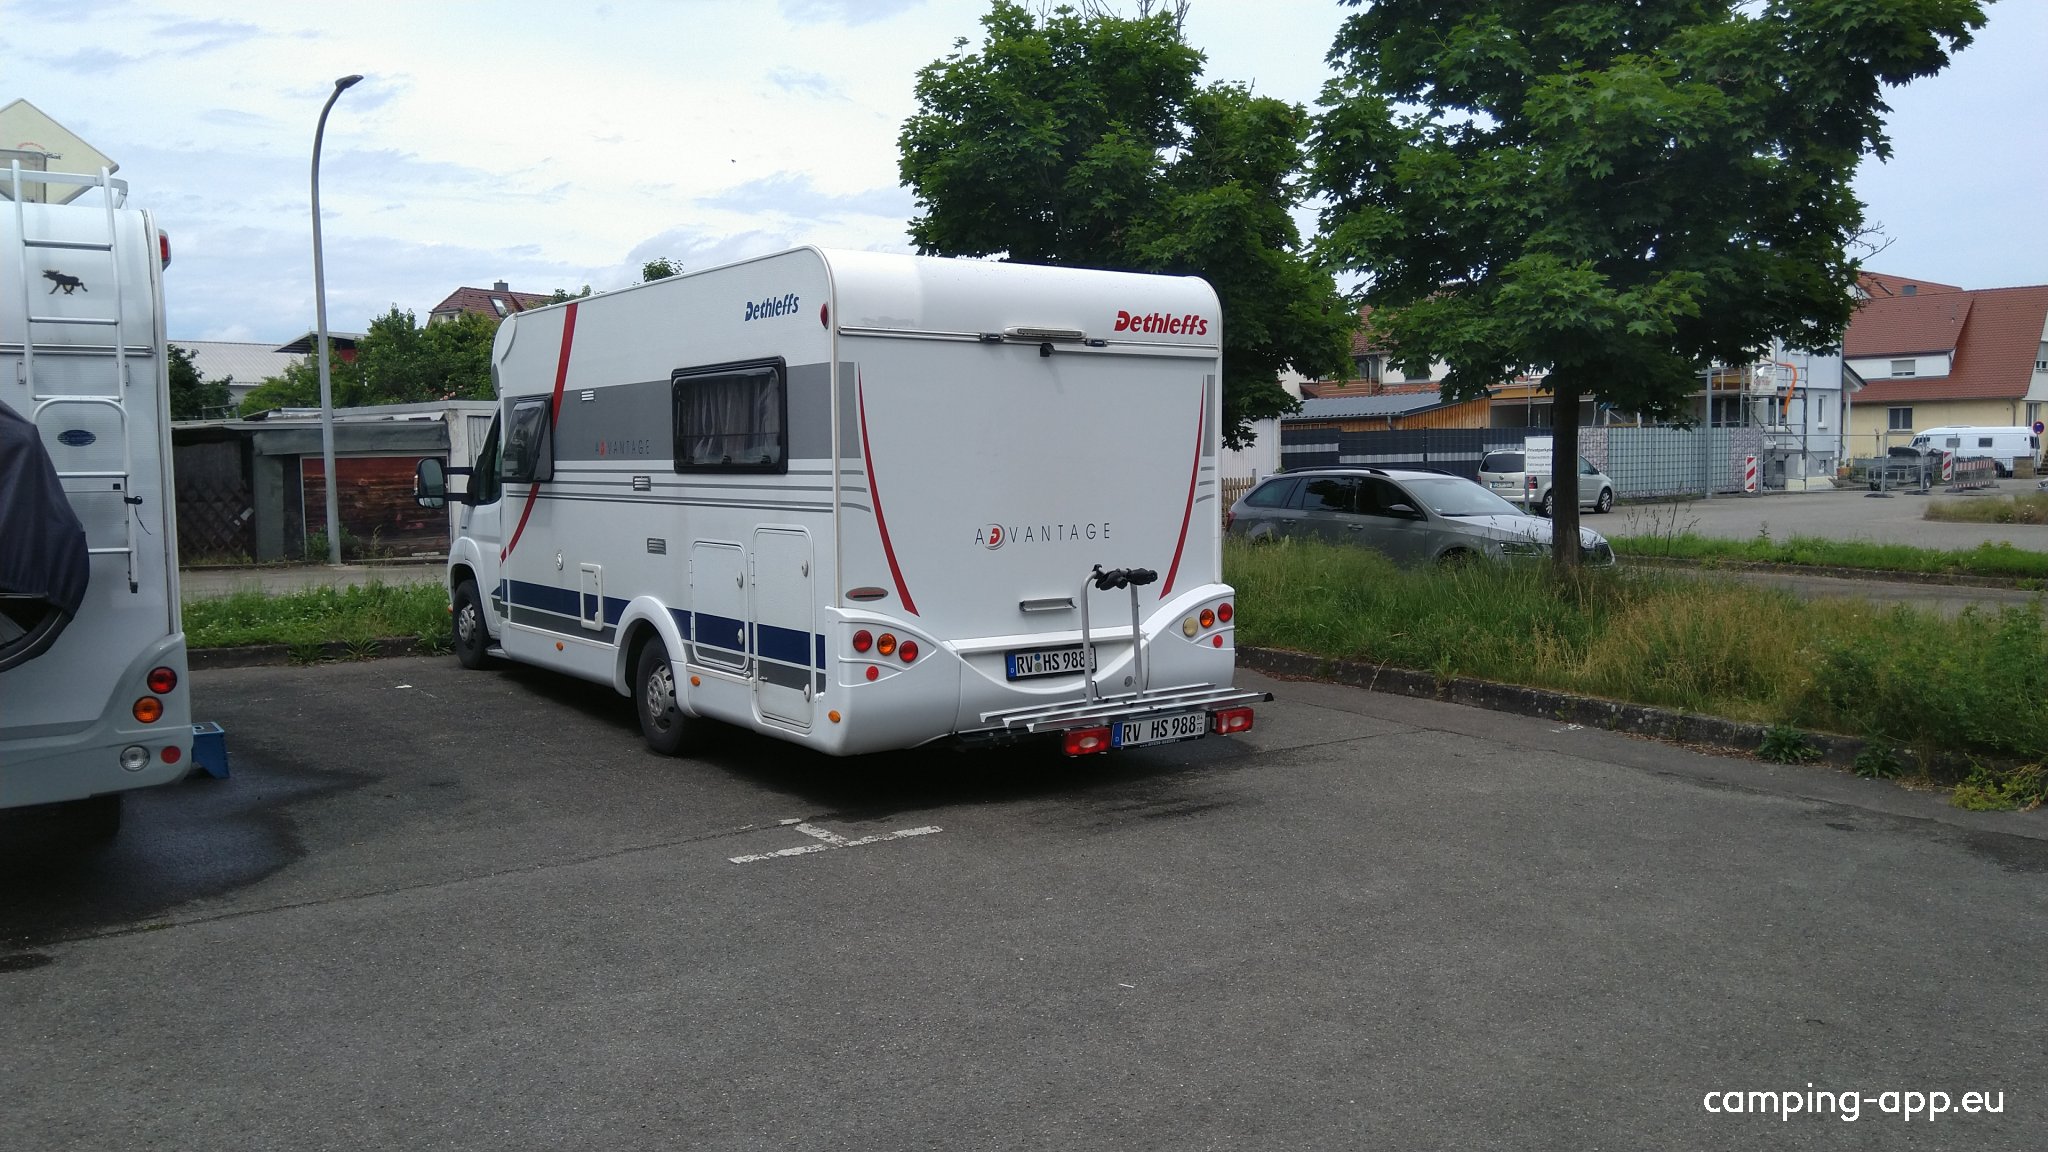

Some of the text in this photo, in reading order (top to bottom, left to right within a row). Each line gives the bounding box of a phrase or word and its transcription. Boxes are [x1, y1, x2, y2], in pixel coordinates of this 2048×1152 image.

[744, 293, 800, 322] Dethleffs
[1113, 310, 1208, 336] Dethleffs
[975, 522, 1110, 550] ADVANTAGE
[1016, 655, 1033, 674] RV
[1043, 653, 1060, 671] HS
[1063, 651, 1085, 669] 988
[1122, 715, 1196, 743] RV HS 988
